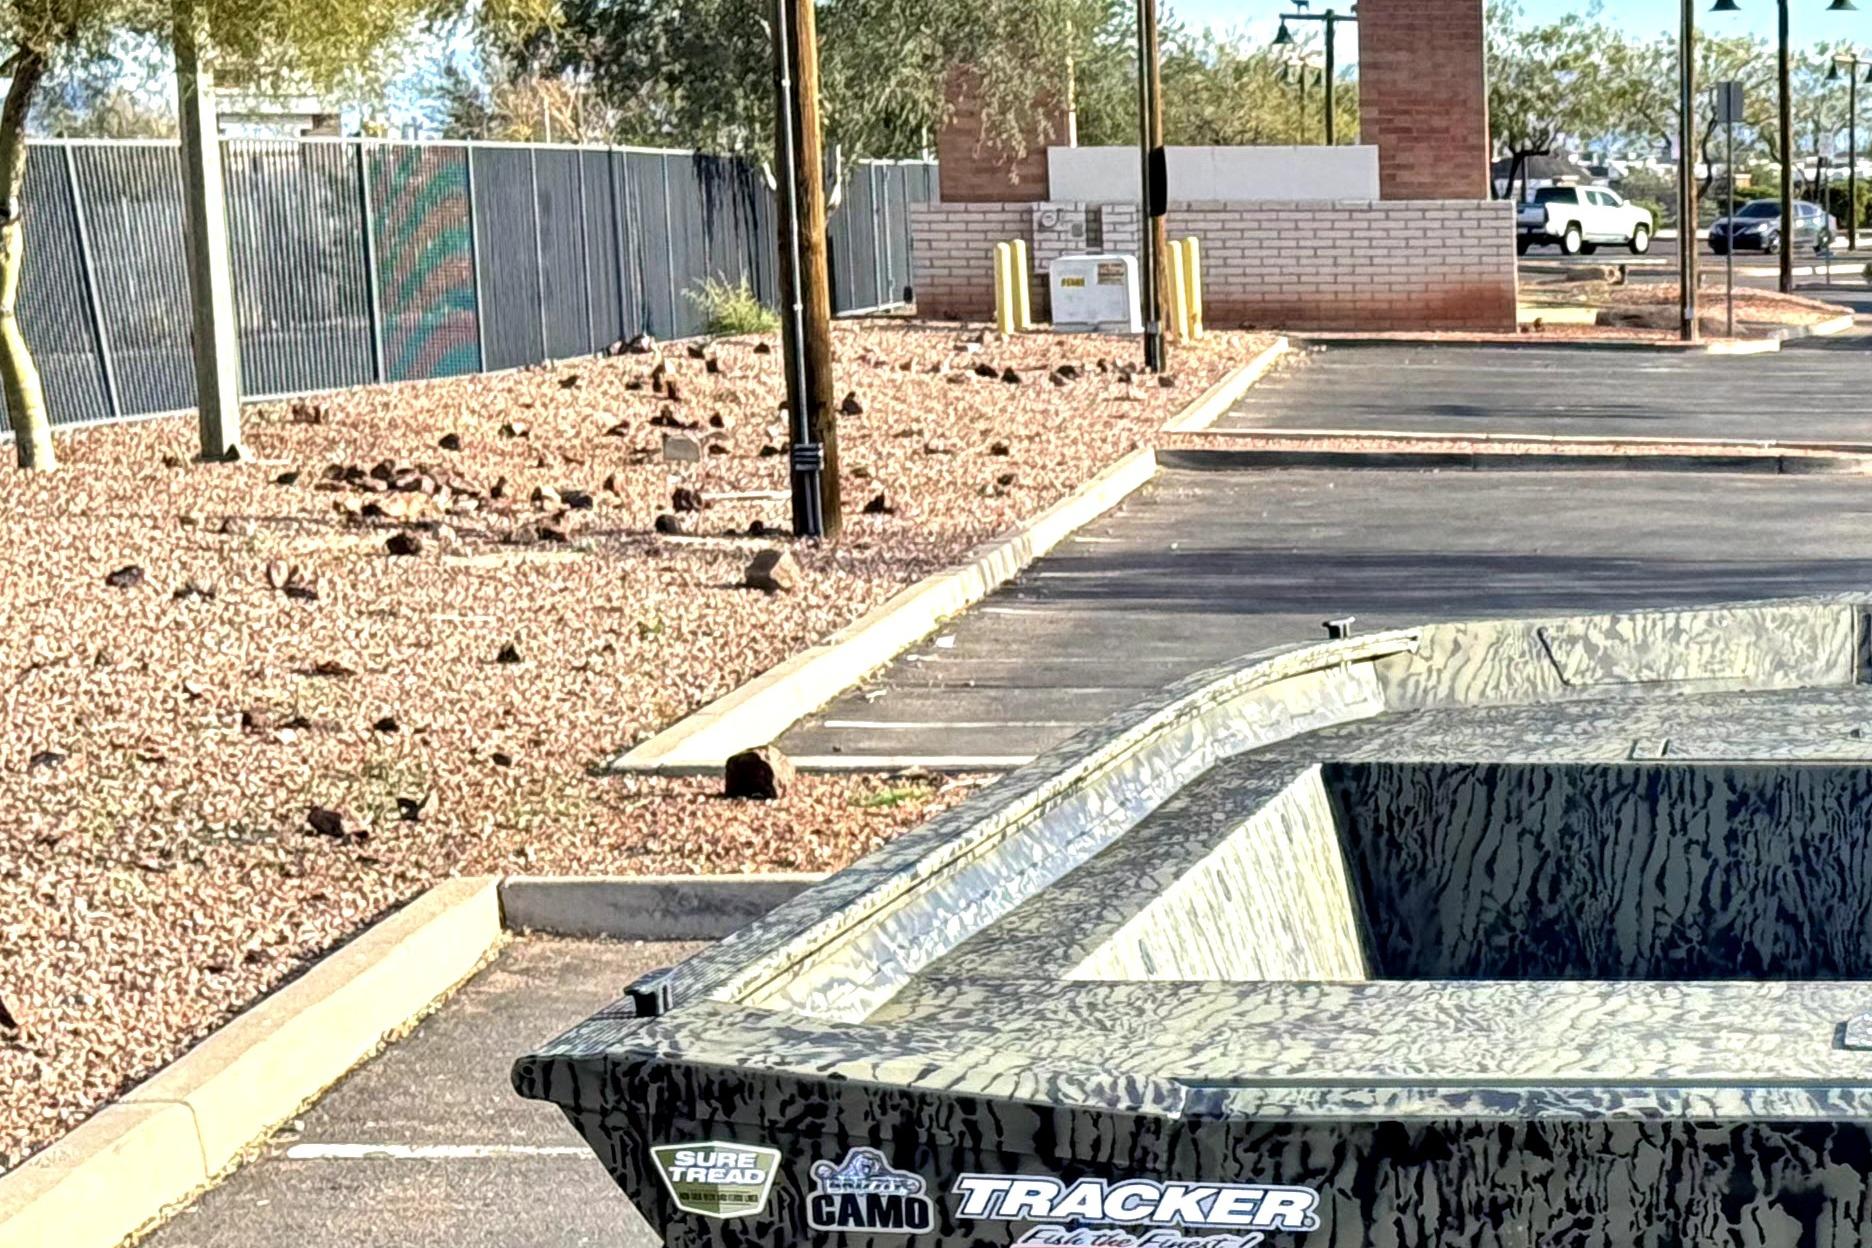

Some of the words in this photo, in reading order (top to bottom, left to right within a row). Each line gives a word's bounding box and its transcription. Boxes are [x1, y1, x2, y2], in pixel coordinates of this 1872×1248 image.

[674, 1150, 757, 1168] SURE
[668, 1166, 766, 1184] TREAD
[812, 1193, 929, 1229] CAMO
[957, 1177, 1314, 1227] TRACKER
[1020, 1229, 1086, 1246] Fish
[1089, 1231, 1134, 1248] the
